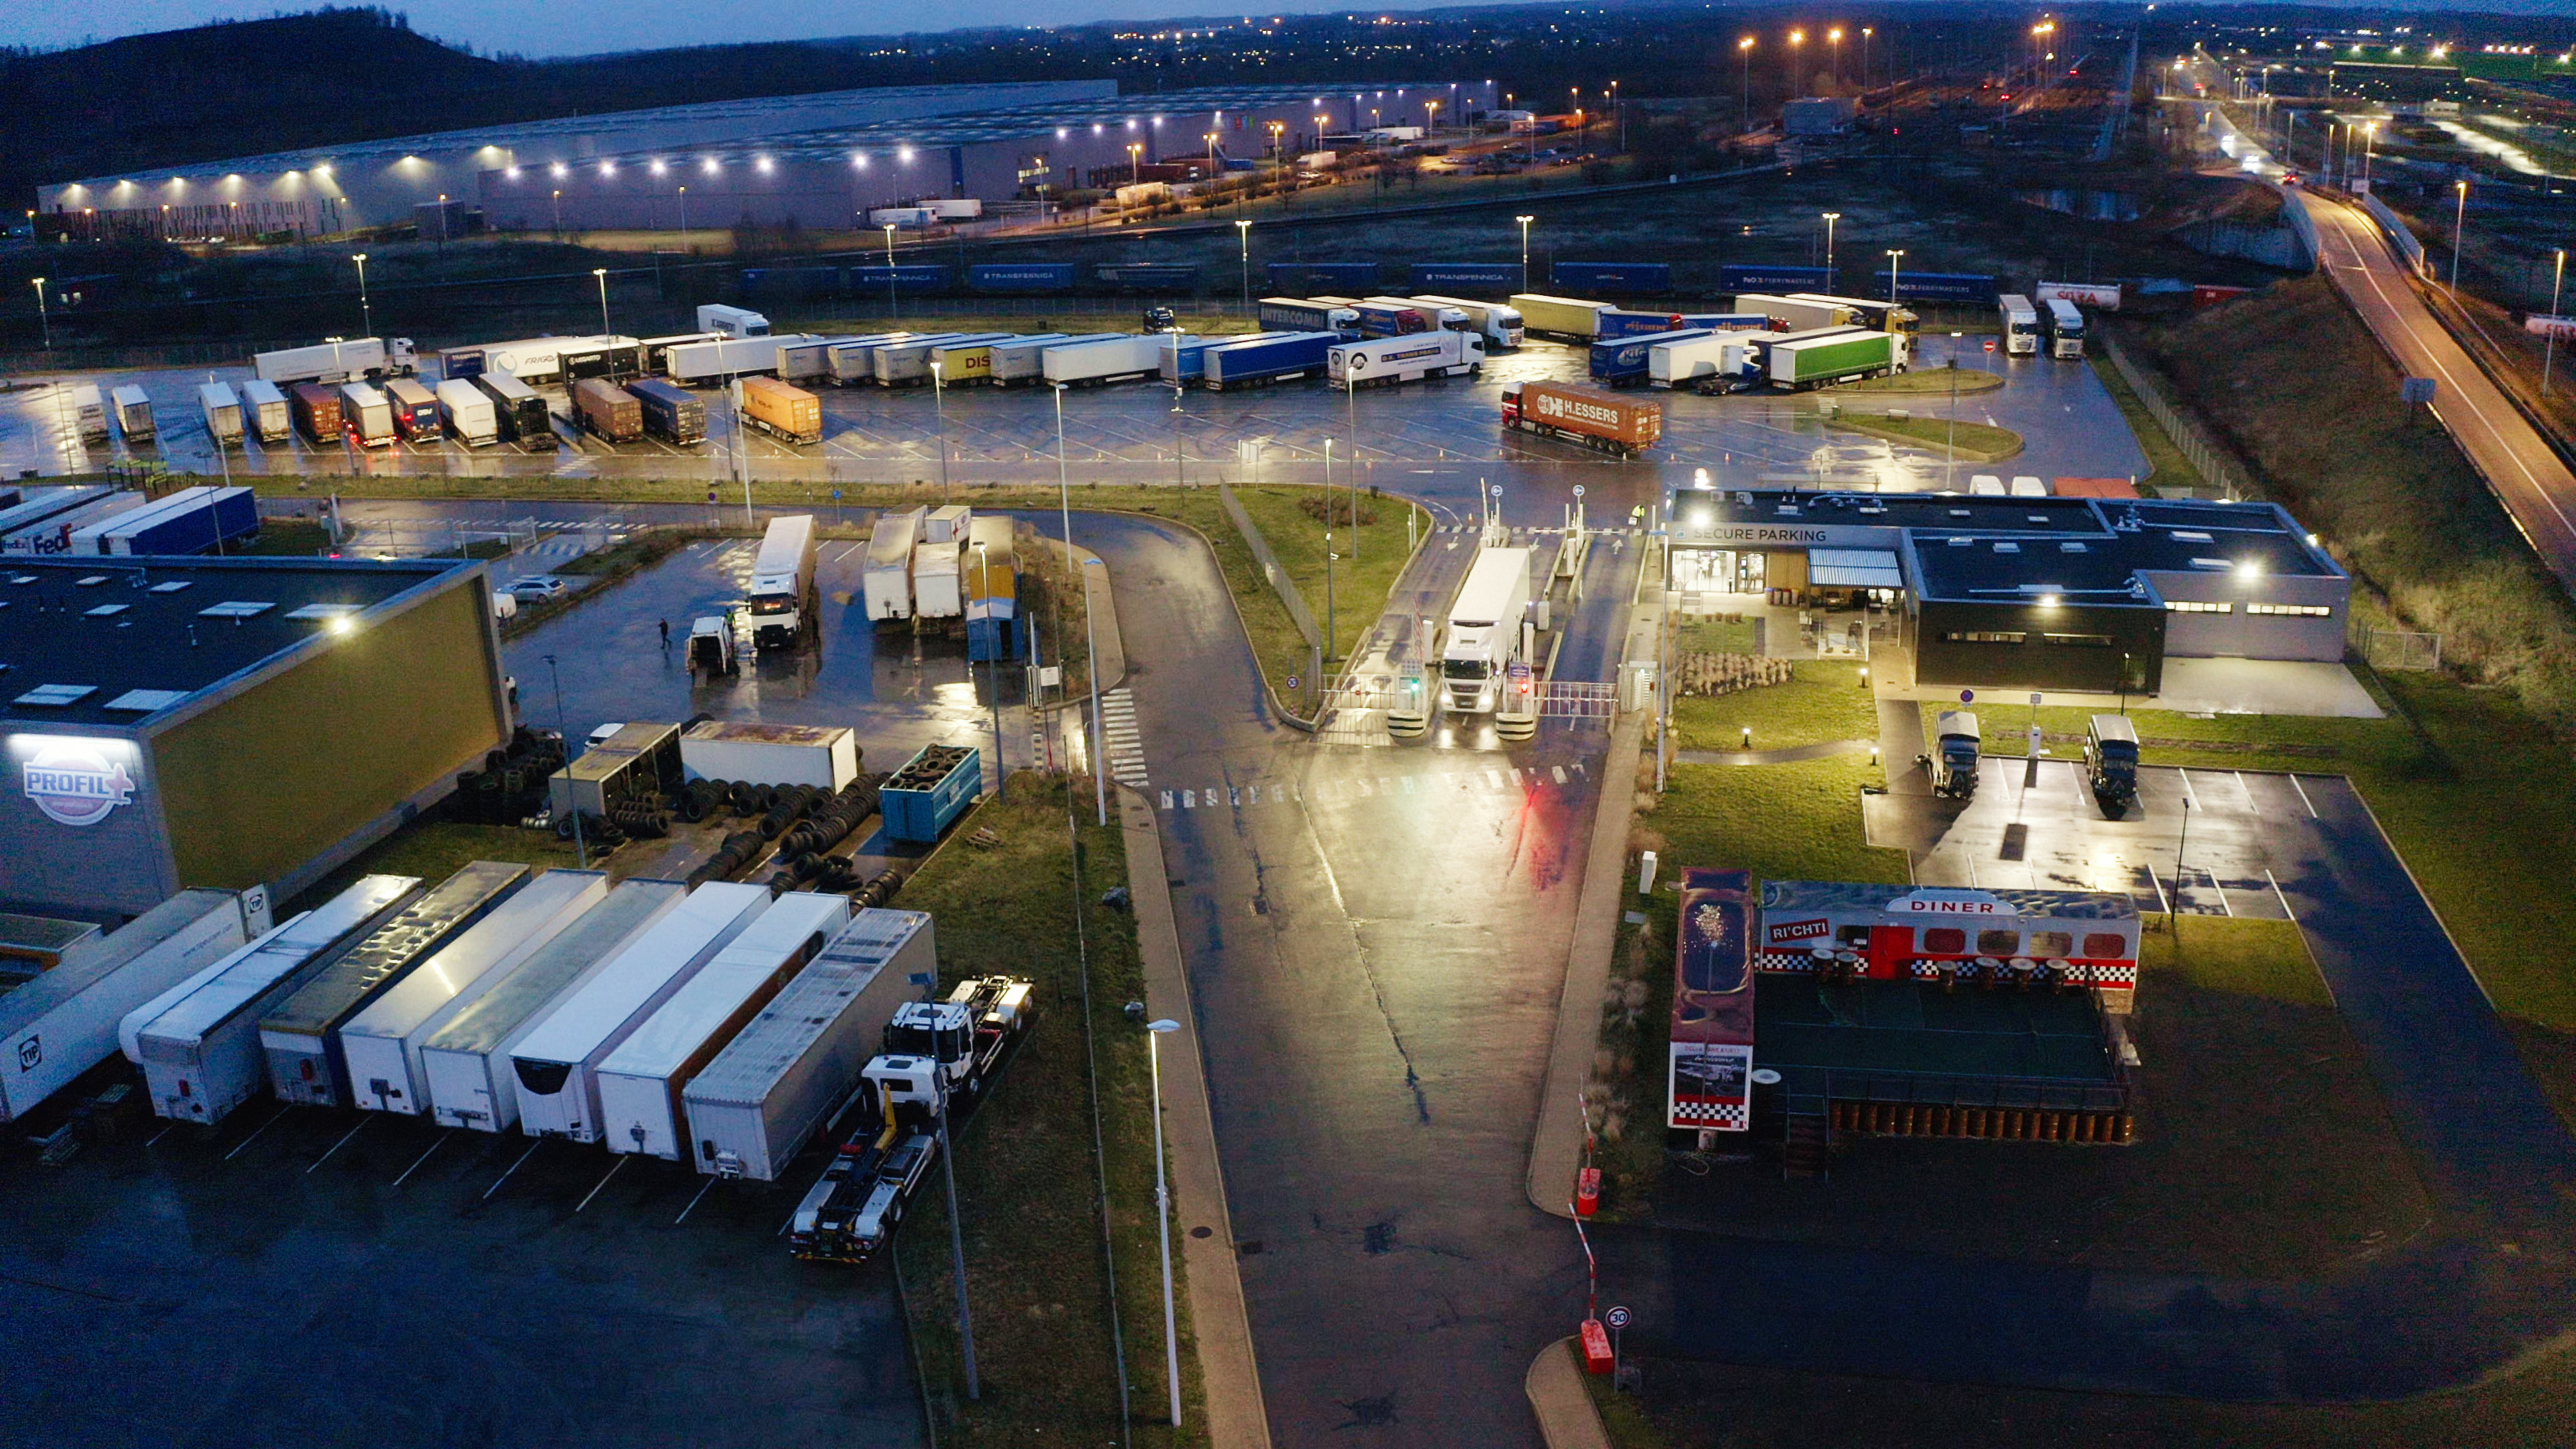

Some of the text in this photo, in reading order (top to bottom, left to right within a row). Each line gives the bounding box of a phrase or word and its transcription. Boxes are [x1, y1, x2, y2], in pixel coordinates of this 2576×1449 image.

[1564, 400, 1619, 424] H.ESSERS
[1694, 528, 1827, 542] SECURE PARKING
[1911, 900, 1994, 913] DINER
[1772, 922, 1827, 940] RI'CHTI
[1611, 1313, 1627, 1323] 30
